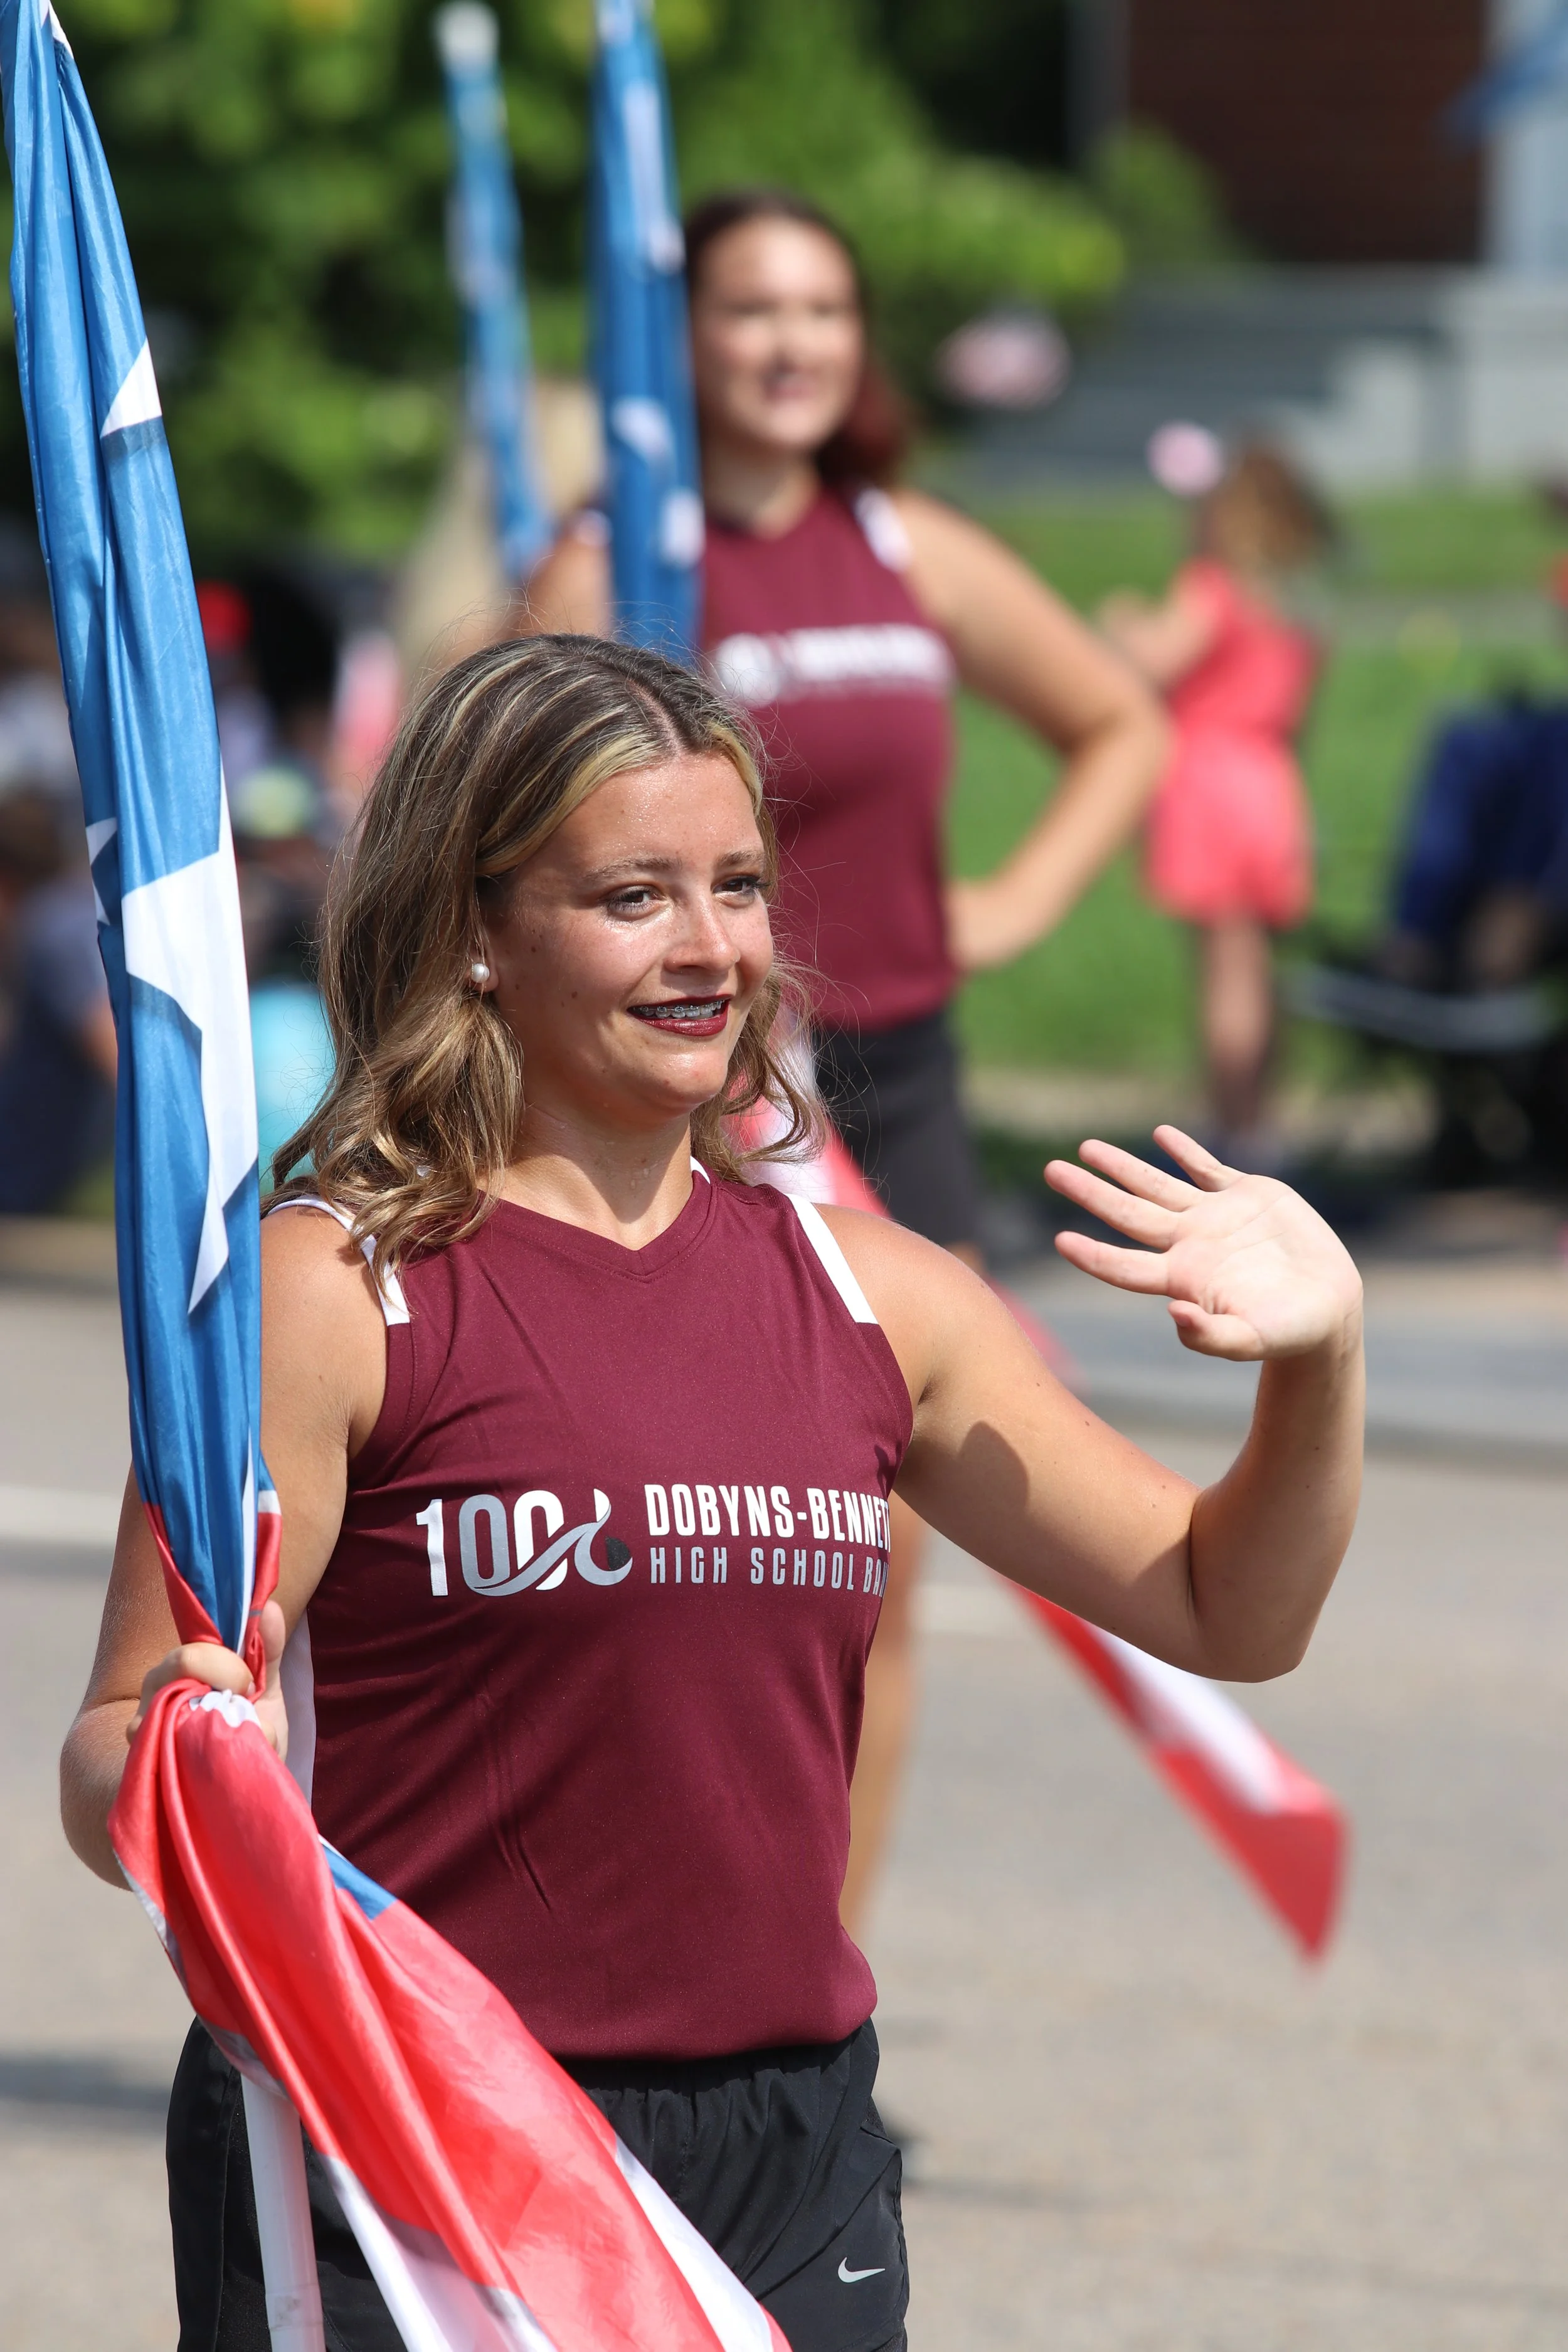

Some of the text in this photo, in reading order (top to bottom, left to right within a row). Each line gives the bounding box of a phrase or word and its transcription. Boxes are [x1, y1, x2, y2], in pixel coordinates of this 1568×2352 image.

[650, 1546, 889, 1597] HIGH SCHOOL BAN
